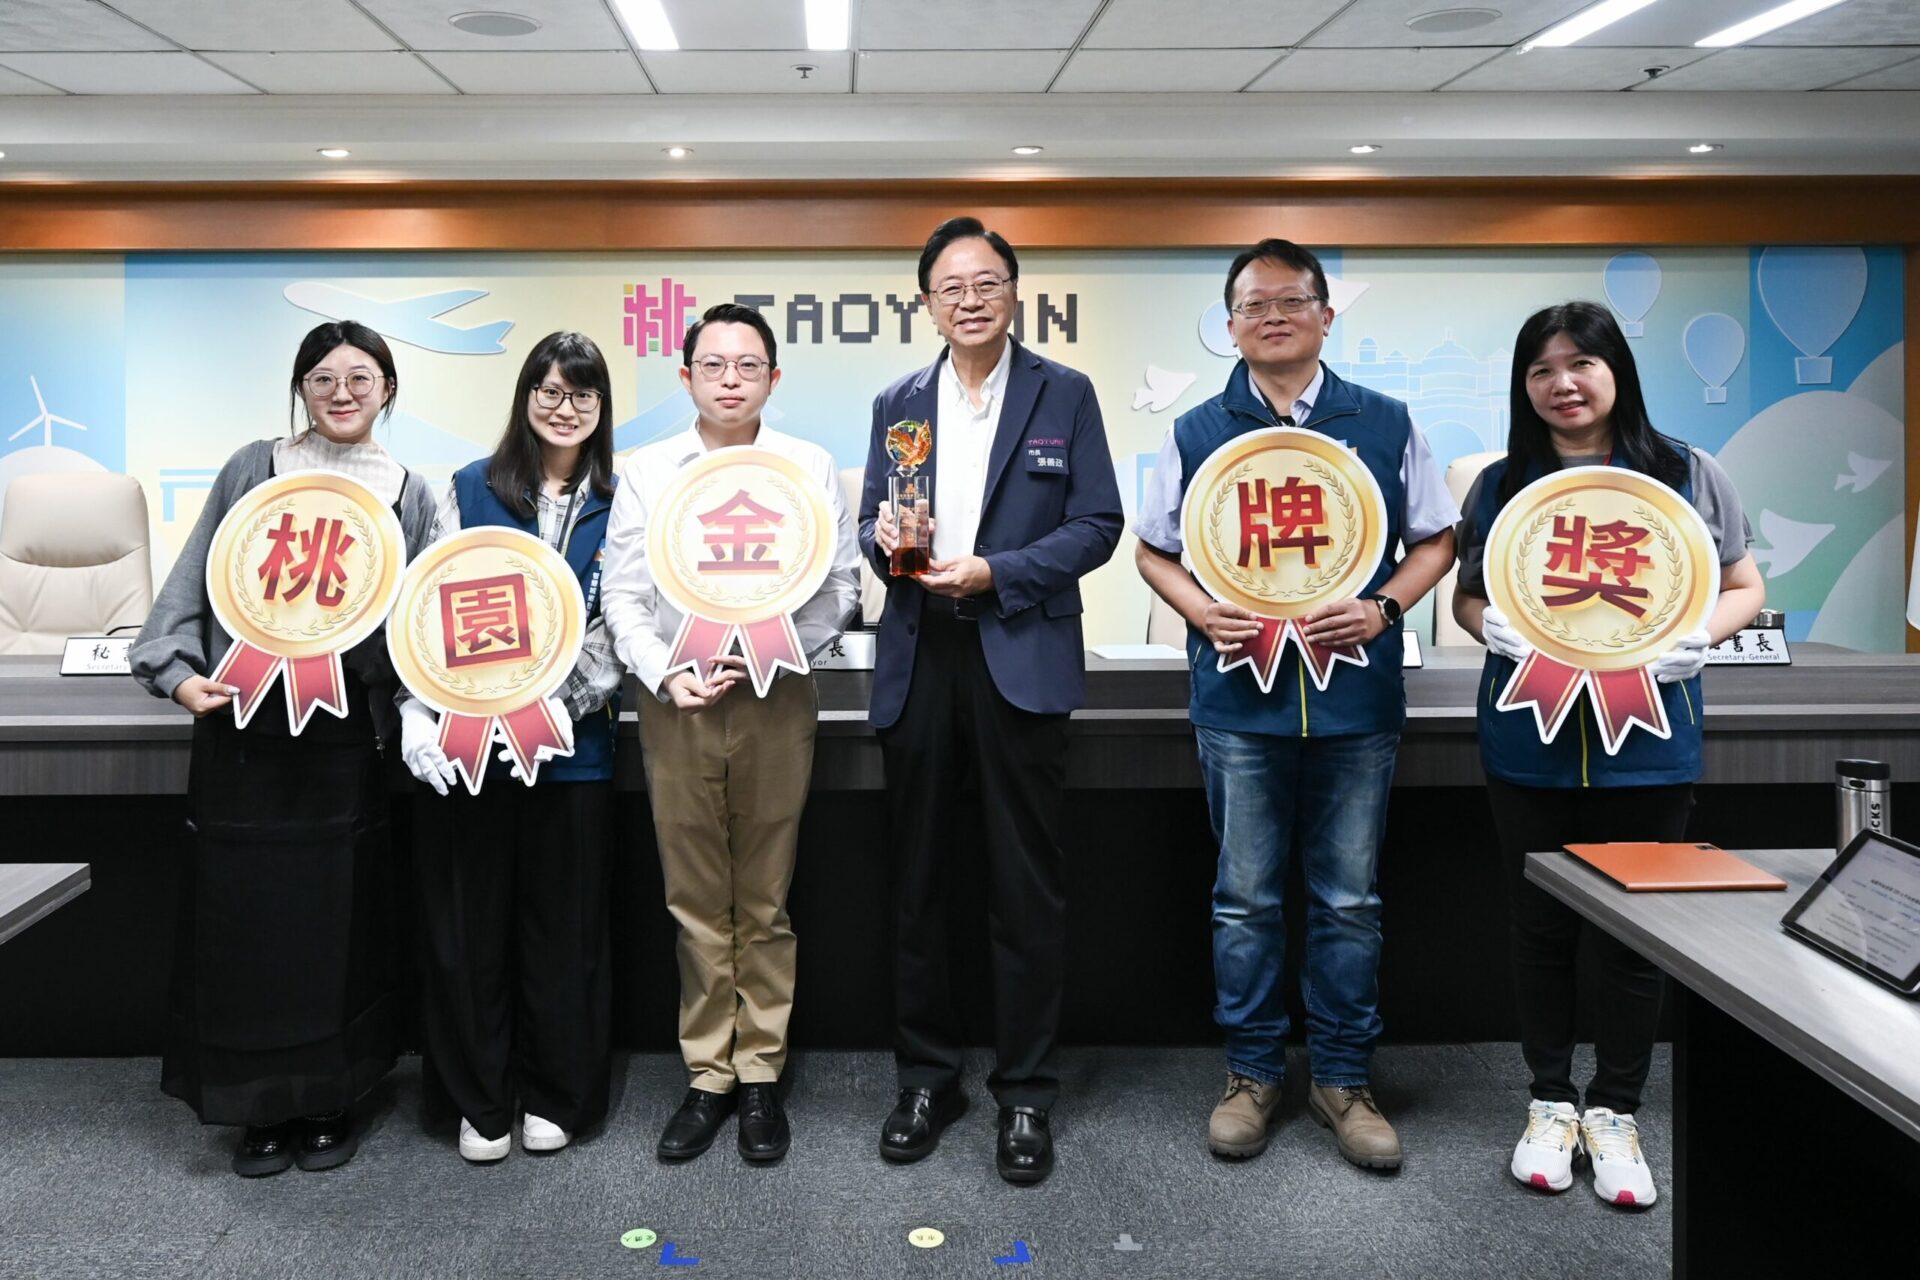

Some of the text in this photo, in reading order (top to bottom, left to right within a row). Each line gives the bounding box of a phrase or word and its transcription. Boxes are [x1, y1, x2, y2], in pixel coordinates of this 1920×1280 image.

[736, 293, 1077, 343] TAOYN
[1037, 457, 1063, 468] 張善政
[697, 490, 785, 573] 金
[1236, 476, 1331, 569] 牌
[258, 513, 358, 608] 桃
[1541, 515, 1652, 620] 獎
[440, 574, 532, 670] 園
[828, 640, 846, 658] 長
[1708, 633, 1774, 652] 書長
[1707, 653, 1780, 662] Secretary-General
